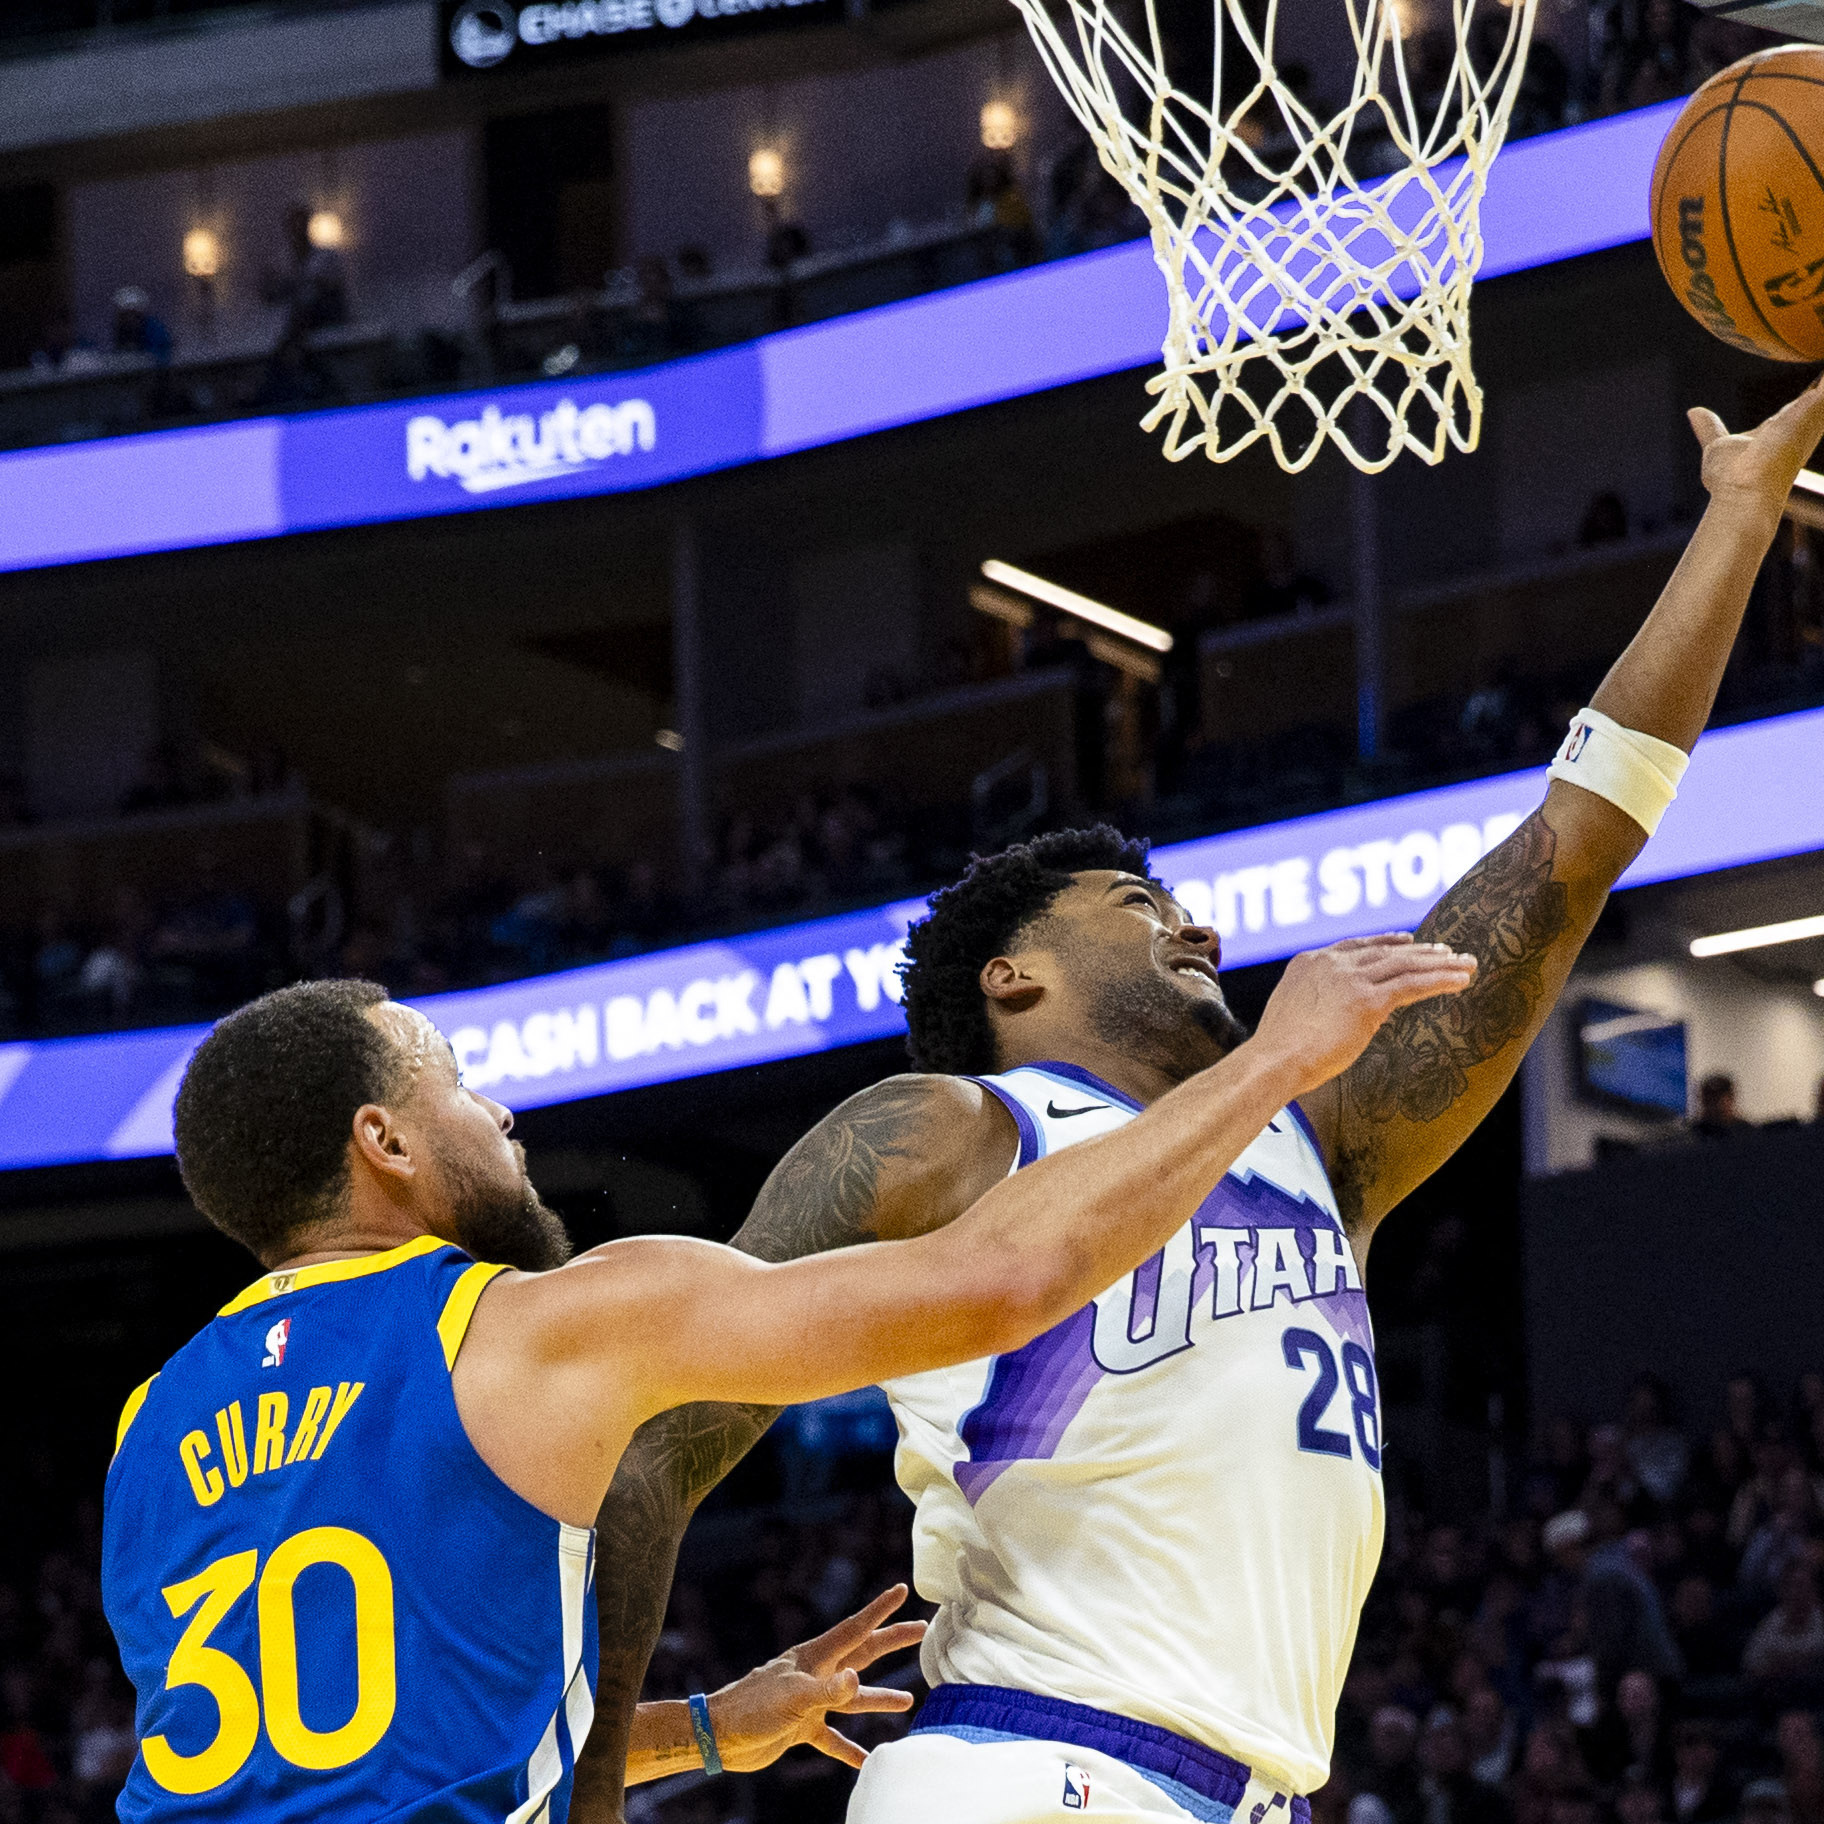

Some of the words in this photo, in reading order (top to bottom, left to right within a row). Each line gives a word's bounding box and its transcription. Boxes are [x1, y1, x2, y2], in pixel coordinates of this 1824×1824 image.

[406, 399, 656, 483] Rakuten
[1176, 857, 1313, 938] RITE
[448, 1004, 599, 1086] CASH
[604, 970, 759, 1060] BACK
[766, 952, 842, 1027] AT
[844, 937, 909, 1012] YO
[1091, 1215, 1366, 1376] UTAH
[179, 1381, 366, 1508] CURRY
[1281, 1326, 1382, 1473] 28
[141, 1526, 396, 1796] 30
